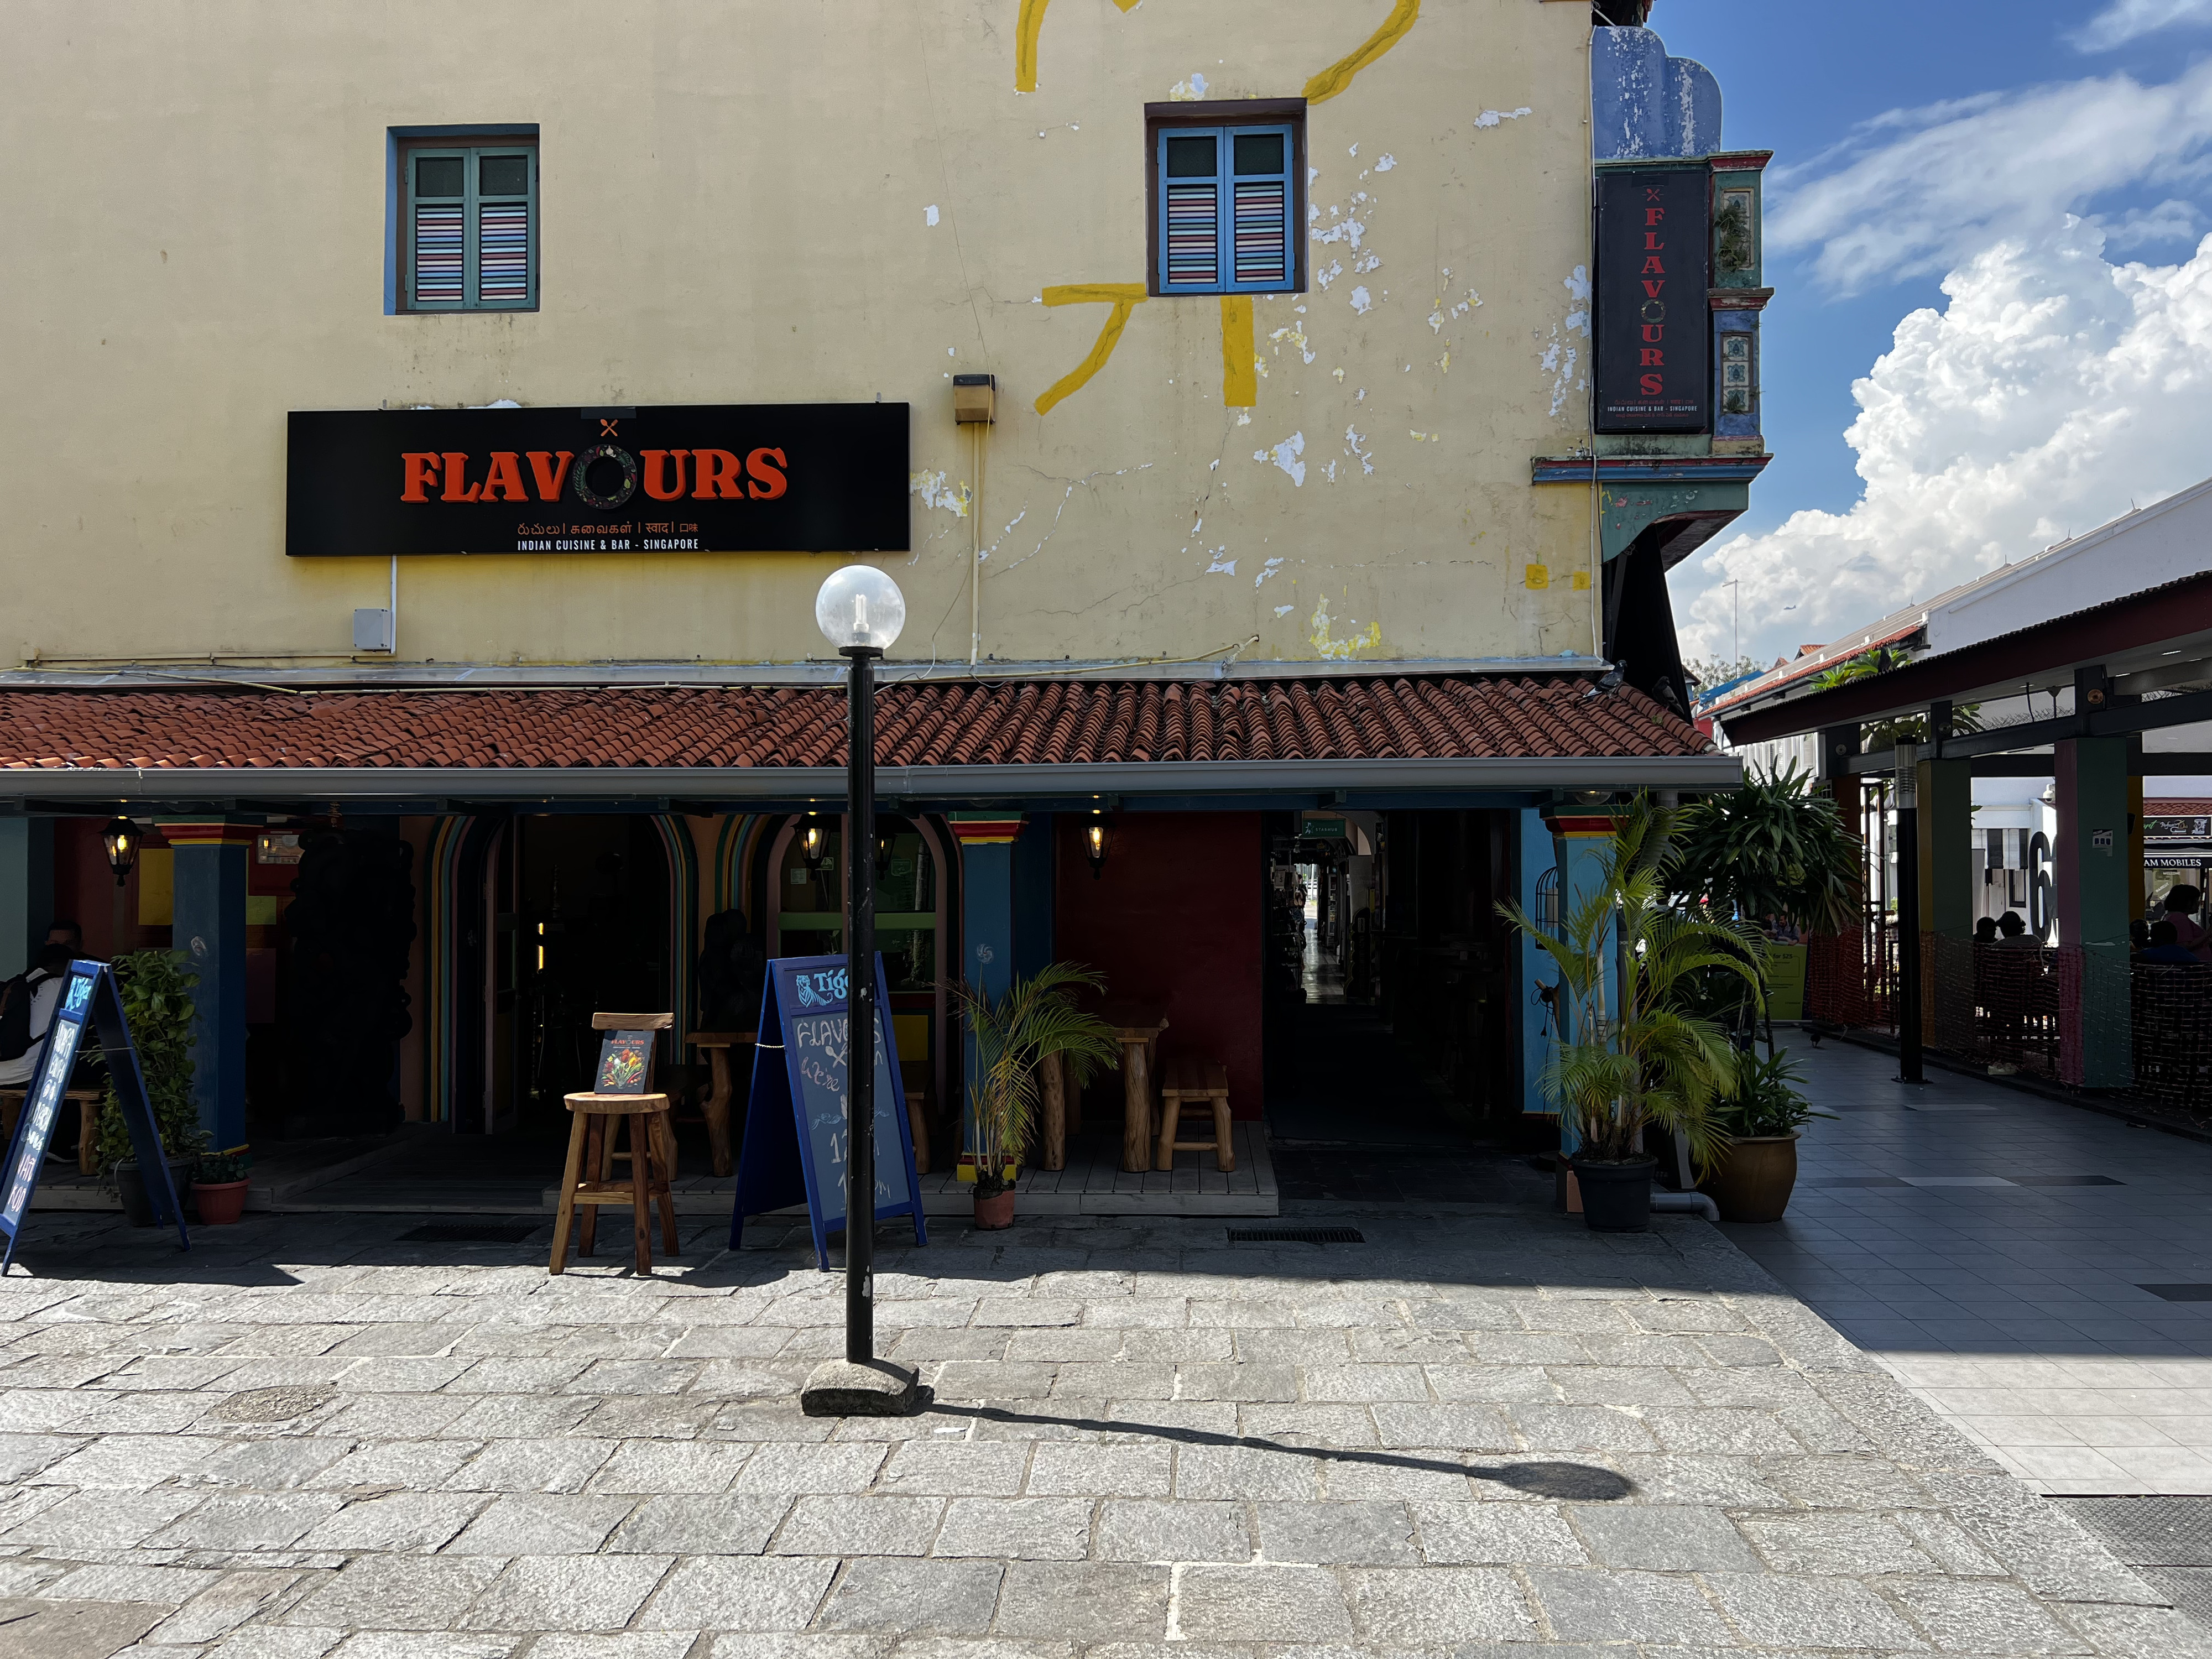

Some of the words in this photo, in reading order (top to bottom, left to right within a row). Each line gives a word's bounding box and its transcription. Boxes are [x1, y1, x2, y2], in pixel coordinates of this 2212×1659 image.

[1640, 208, 1666, 396] FLAVOURS
[401, 445, 788, 509] FLAVOURS
[518, 540, 551, 550] INDIAN
[556, 540, 595, 550] CUISINE
[600, 540, 607, 550] &
[612, 539, 630, 550] BAR
[644, 539, 698, 549] SINGAPORE
